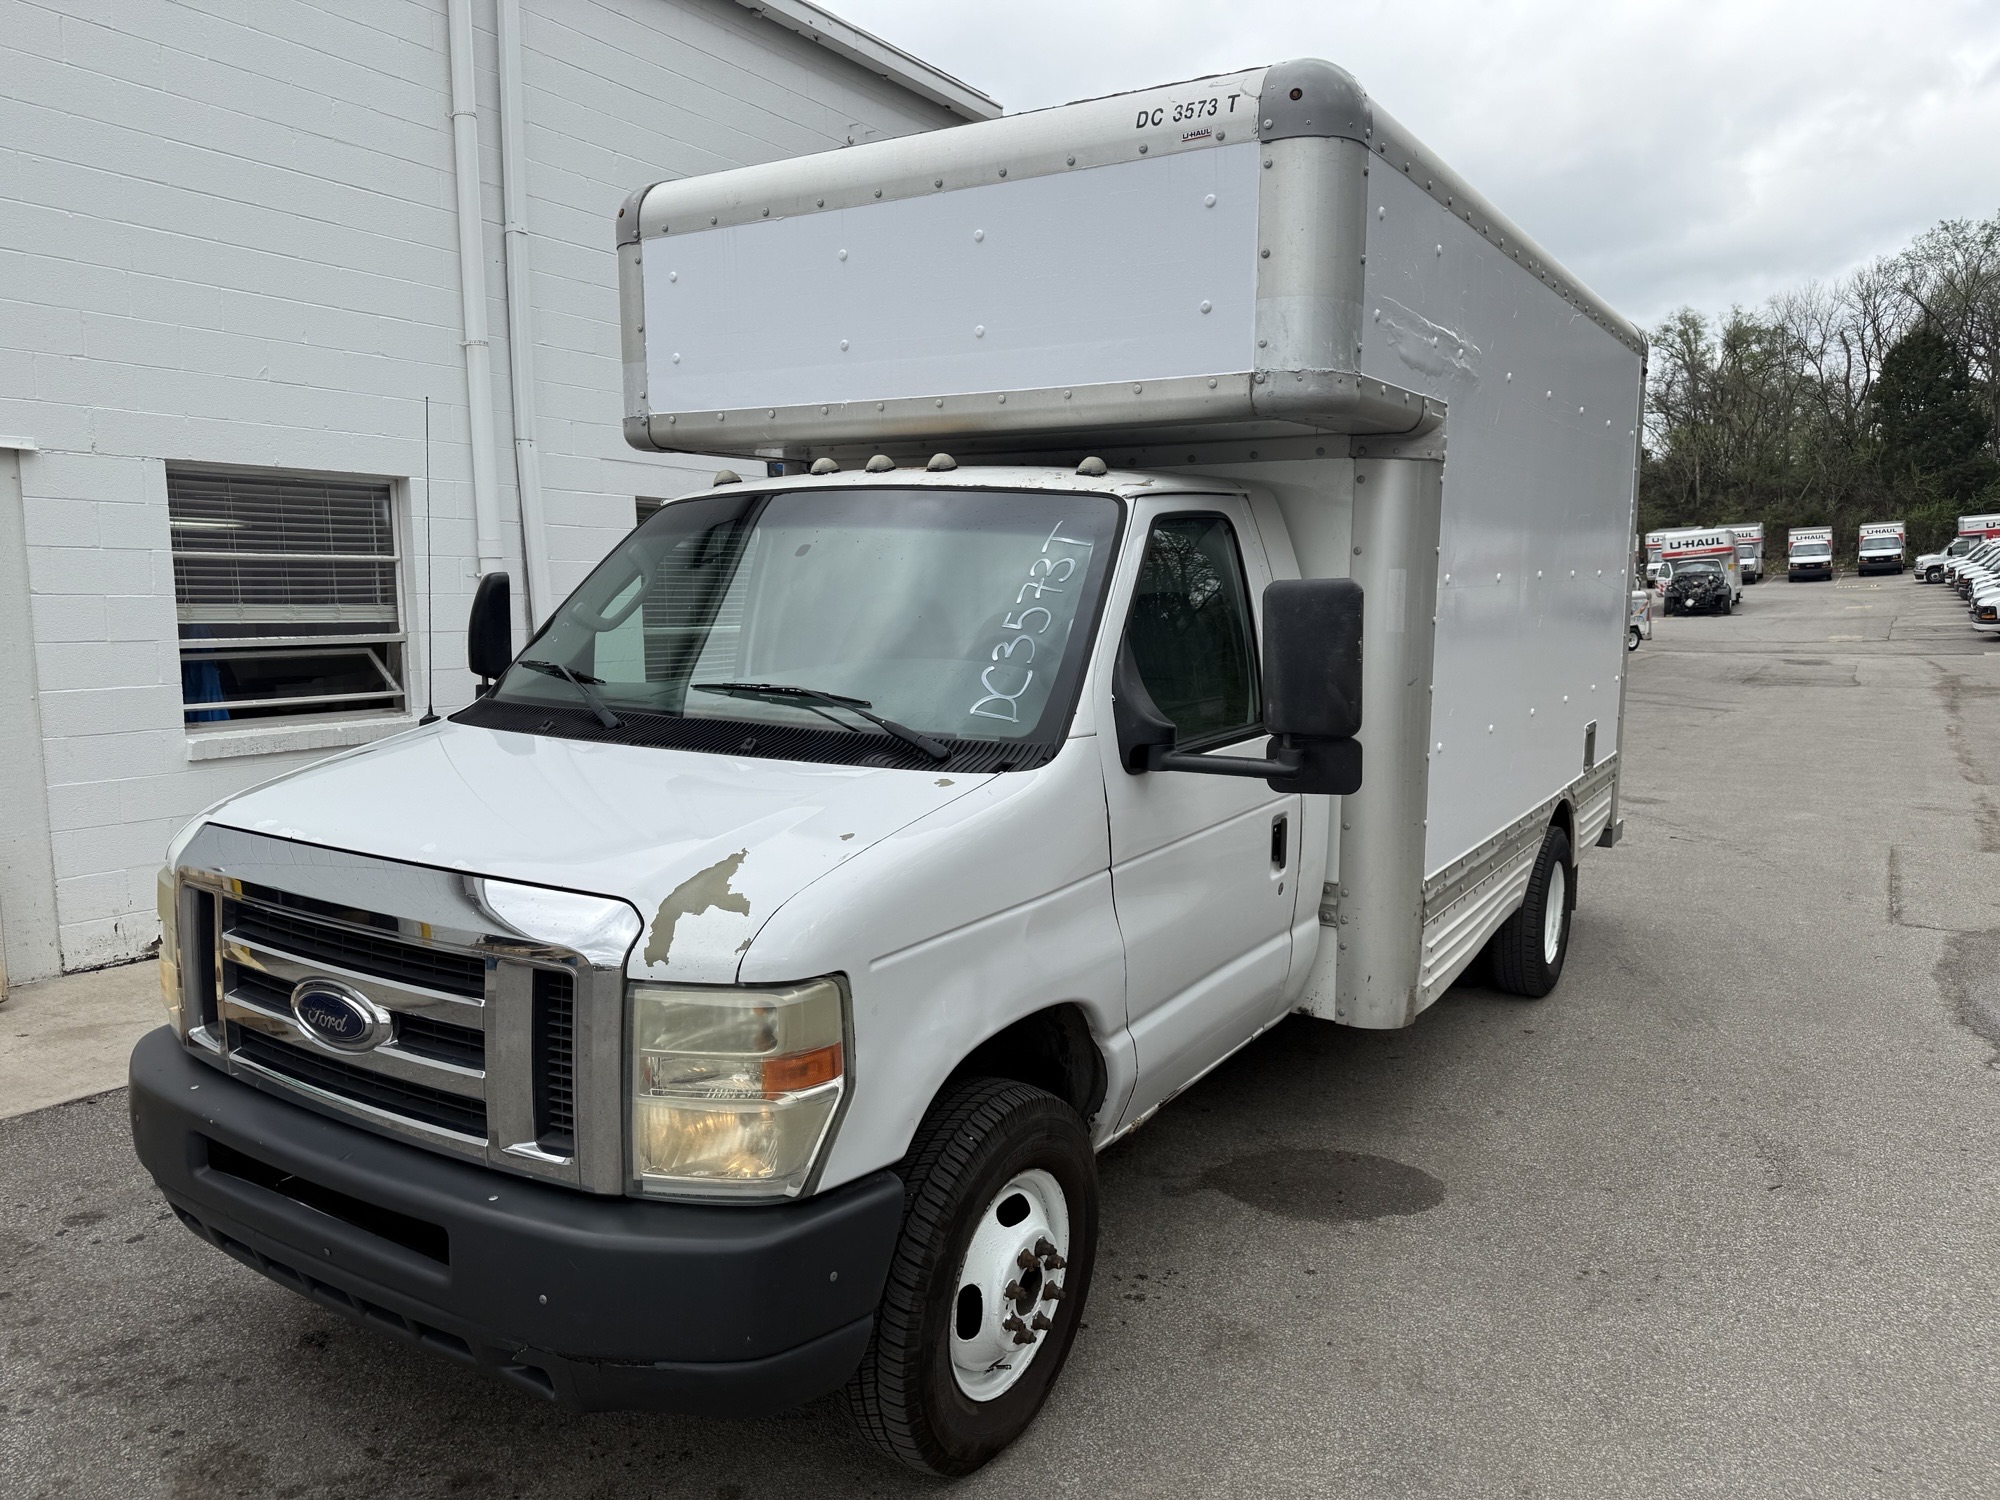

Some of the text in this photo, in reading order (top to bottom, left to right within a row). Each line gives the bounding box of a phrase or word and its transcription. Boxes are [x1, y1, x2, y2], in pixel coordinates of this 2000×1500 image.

[1136, 94, 1241, 129] DC 3573 T
[1182, 128, 1211, 140] U-HAUL
[1669, 537, 1724, 550] U-HAUL
[307, 1002, 349, 1033] Ford
